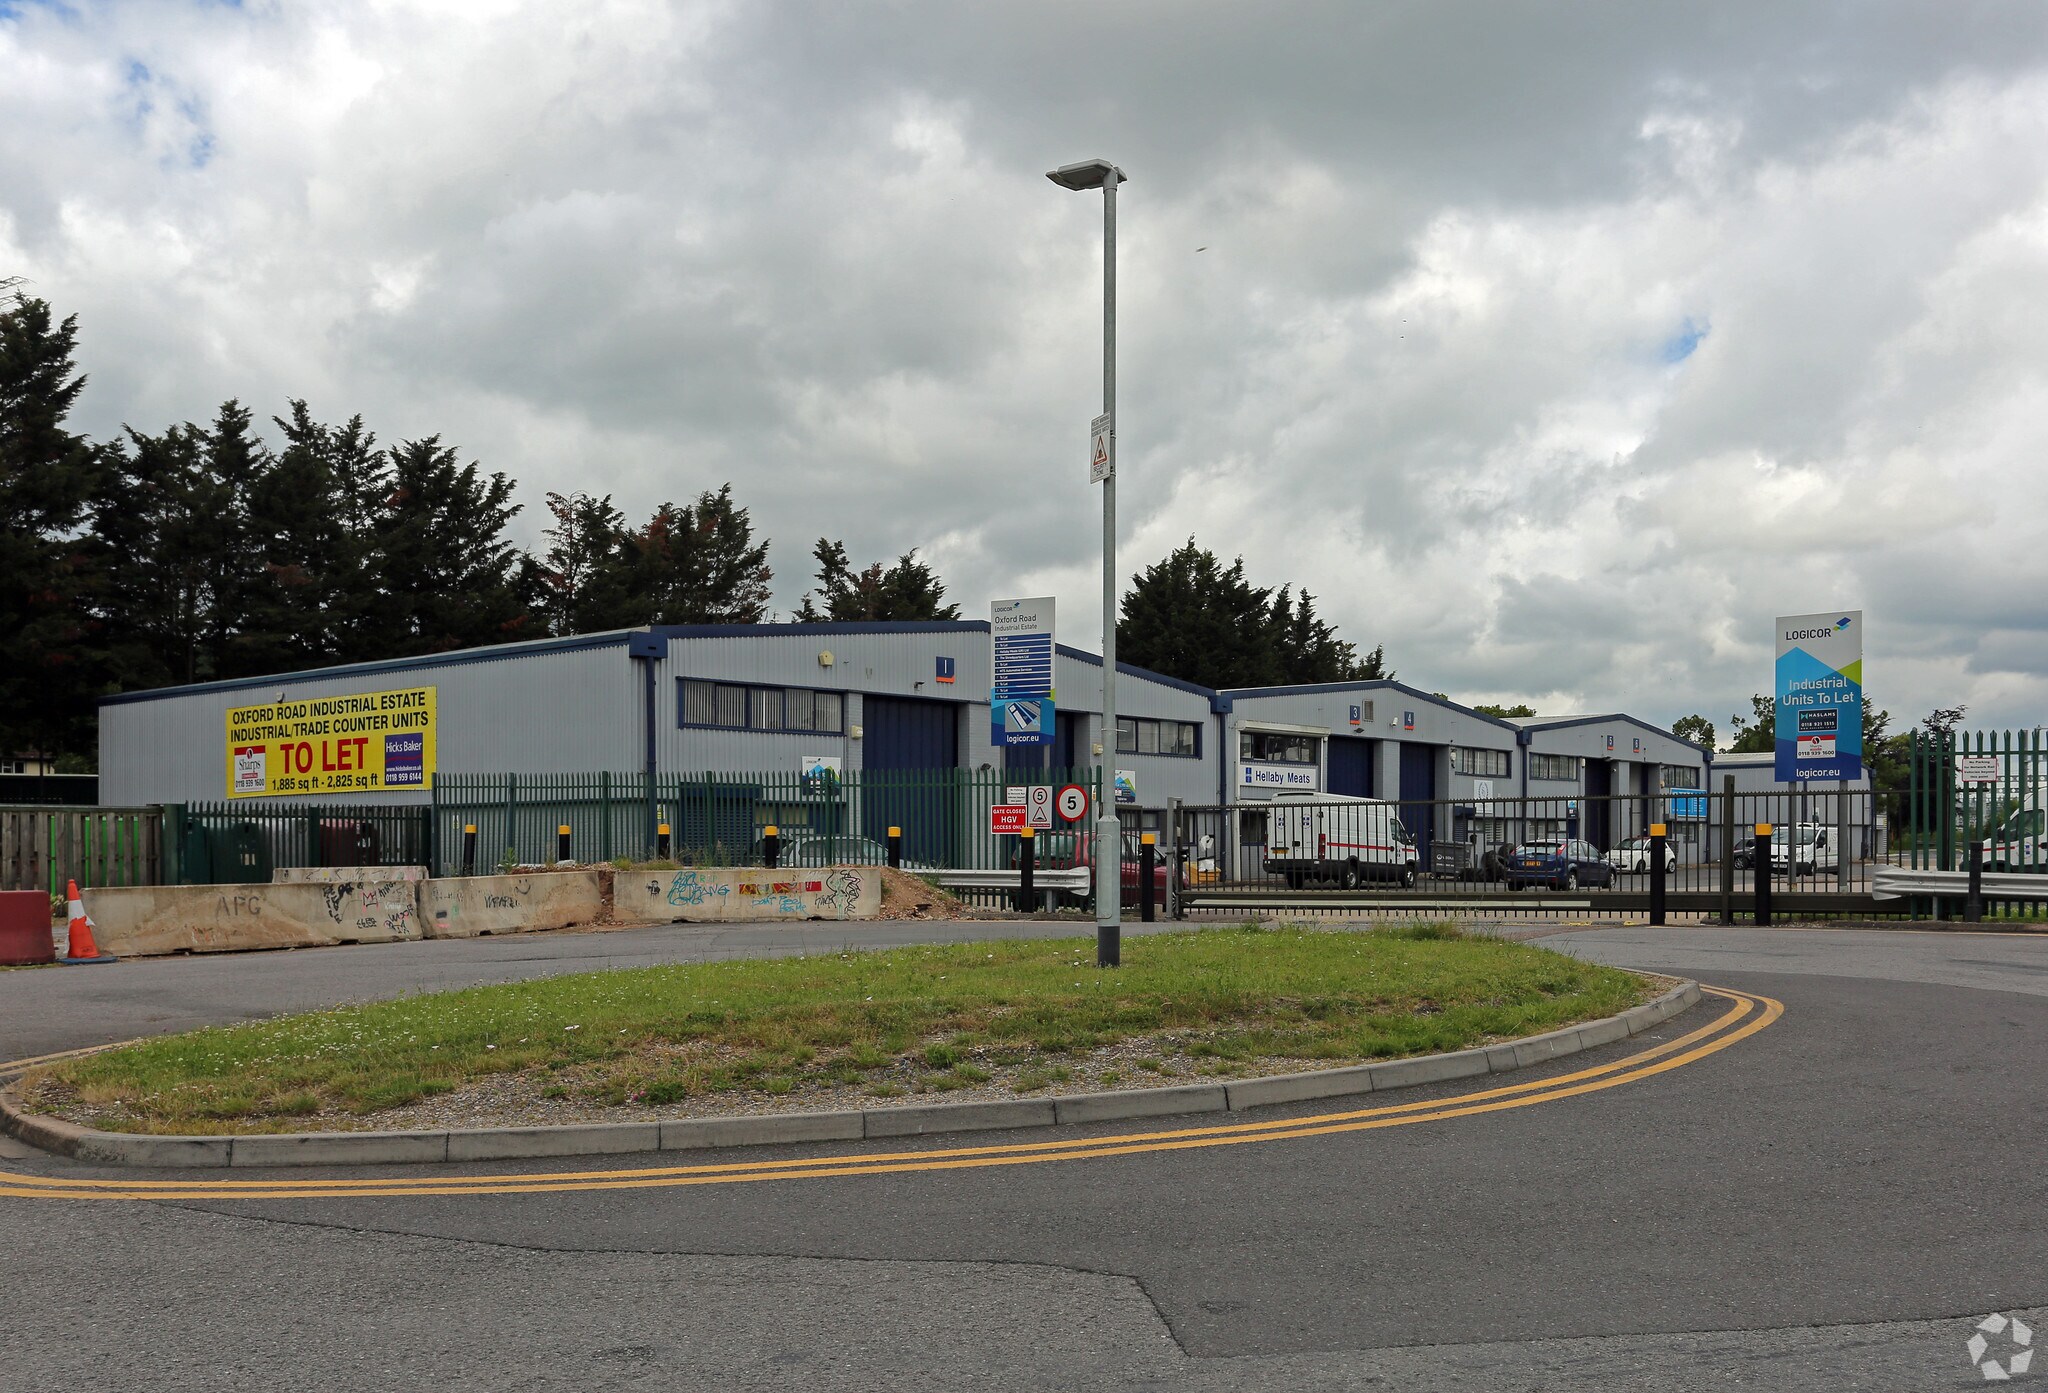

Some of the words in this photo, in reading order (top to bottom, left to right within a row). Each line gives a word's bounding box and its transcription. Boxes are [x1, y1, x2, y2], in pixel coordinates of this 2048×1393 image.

[994, 616, 1018, 624] Oxford
[1018, 614, 1037, 622] Road
[1786, 628, 1832, 640] LOGICOR
[1790, 676, 1847, 690] Industrial
[1783, 694, 1813, 706] Units
[1817, 692, 1830, 704] To
[1835, 692, 1854, 703] Let
[232, 708, 274, 724] OXFORD
[277, 704, 306, 720] ROAD
[310, 697, 377, 716] INDUSTRIAL
[381, 692, 425, 710] ESTATE
[1353, 707, 1357, 718] 3
[1408, 714, 1411, 723] 4
[231, 720, 329, 742] INDUSTRIAL/TRADE
[333, 715, 388, 733] COUNTER
[392, 711, 428, 728] UNITS
[1007, 735, 1039, 744] logicor.eu
[1610, 736, 1612, 745] 5
[386, 742, 402, 752] Hicks
[404, 740, 422, 751] Baker
[280, 741, 313, 774] TO
[322, 737, 368, 771] LET
[239, 759, 260, 772] Sharps
[386, 773, 397, 781] 0118
[409, 772, 422, 780] 6144
[1256, 771, 1283, 784] Hellaby
[1288, 772, 1310, 784] Meats
[1796, 768, 1840, 779] logicor.eu
[272, 778, 295, 792] 1,885
[298, 780, 309, 791] sq
[312, 777, 318, 788] ft
[327, 775, 352, 789] 2,825
[356, 777, 367, 788] sq
[370, 773, 378, 785] ft
[1037, 791, 1043, 800] 5
[1067, 796, 1076, 810] 5
